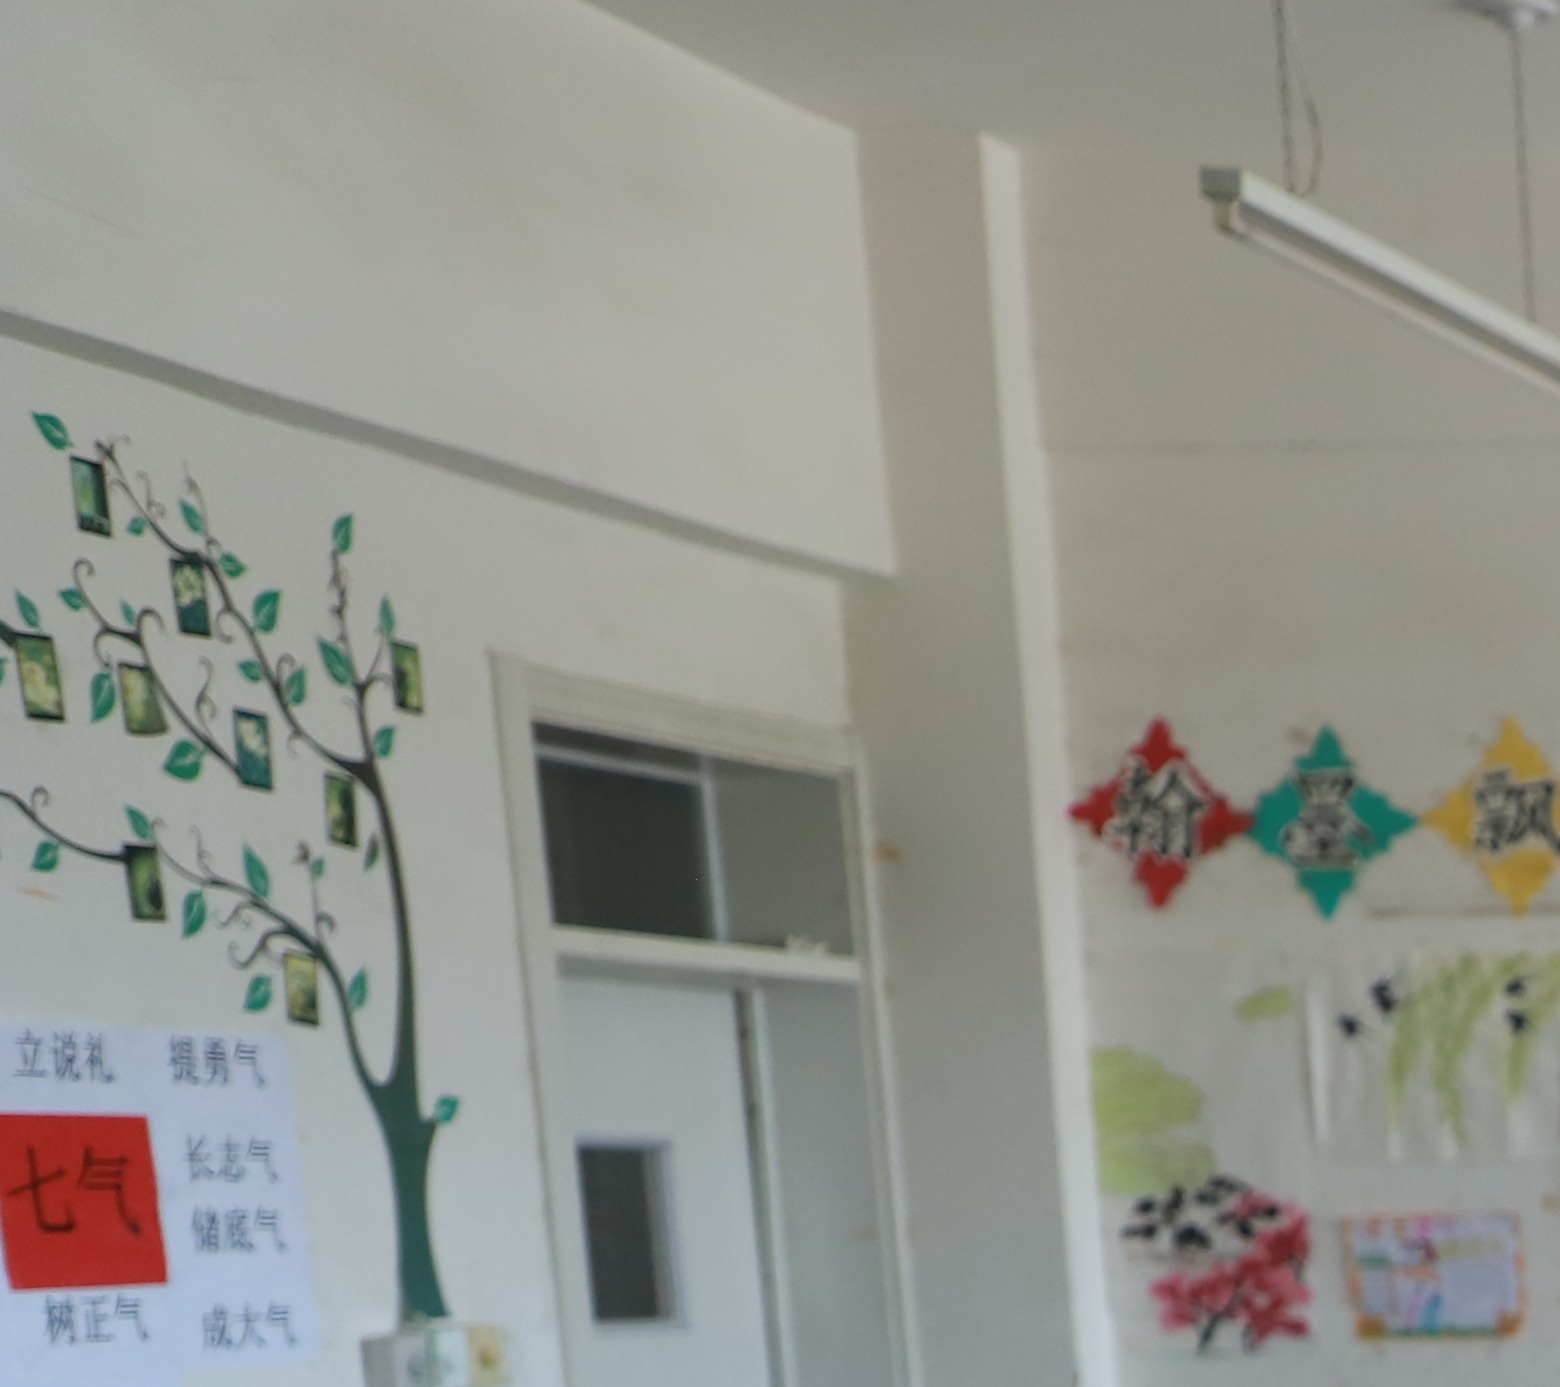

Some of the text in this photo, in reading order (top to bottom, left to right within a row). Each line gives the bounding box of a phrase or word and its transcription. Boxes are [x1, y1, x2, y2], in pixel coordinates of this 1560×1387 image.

[182, 1134, 280, 1185] 长志气
[6, 1144, 144, 1236] 七气
[42, 1292, 152, 1346] 树正气
